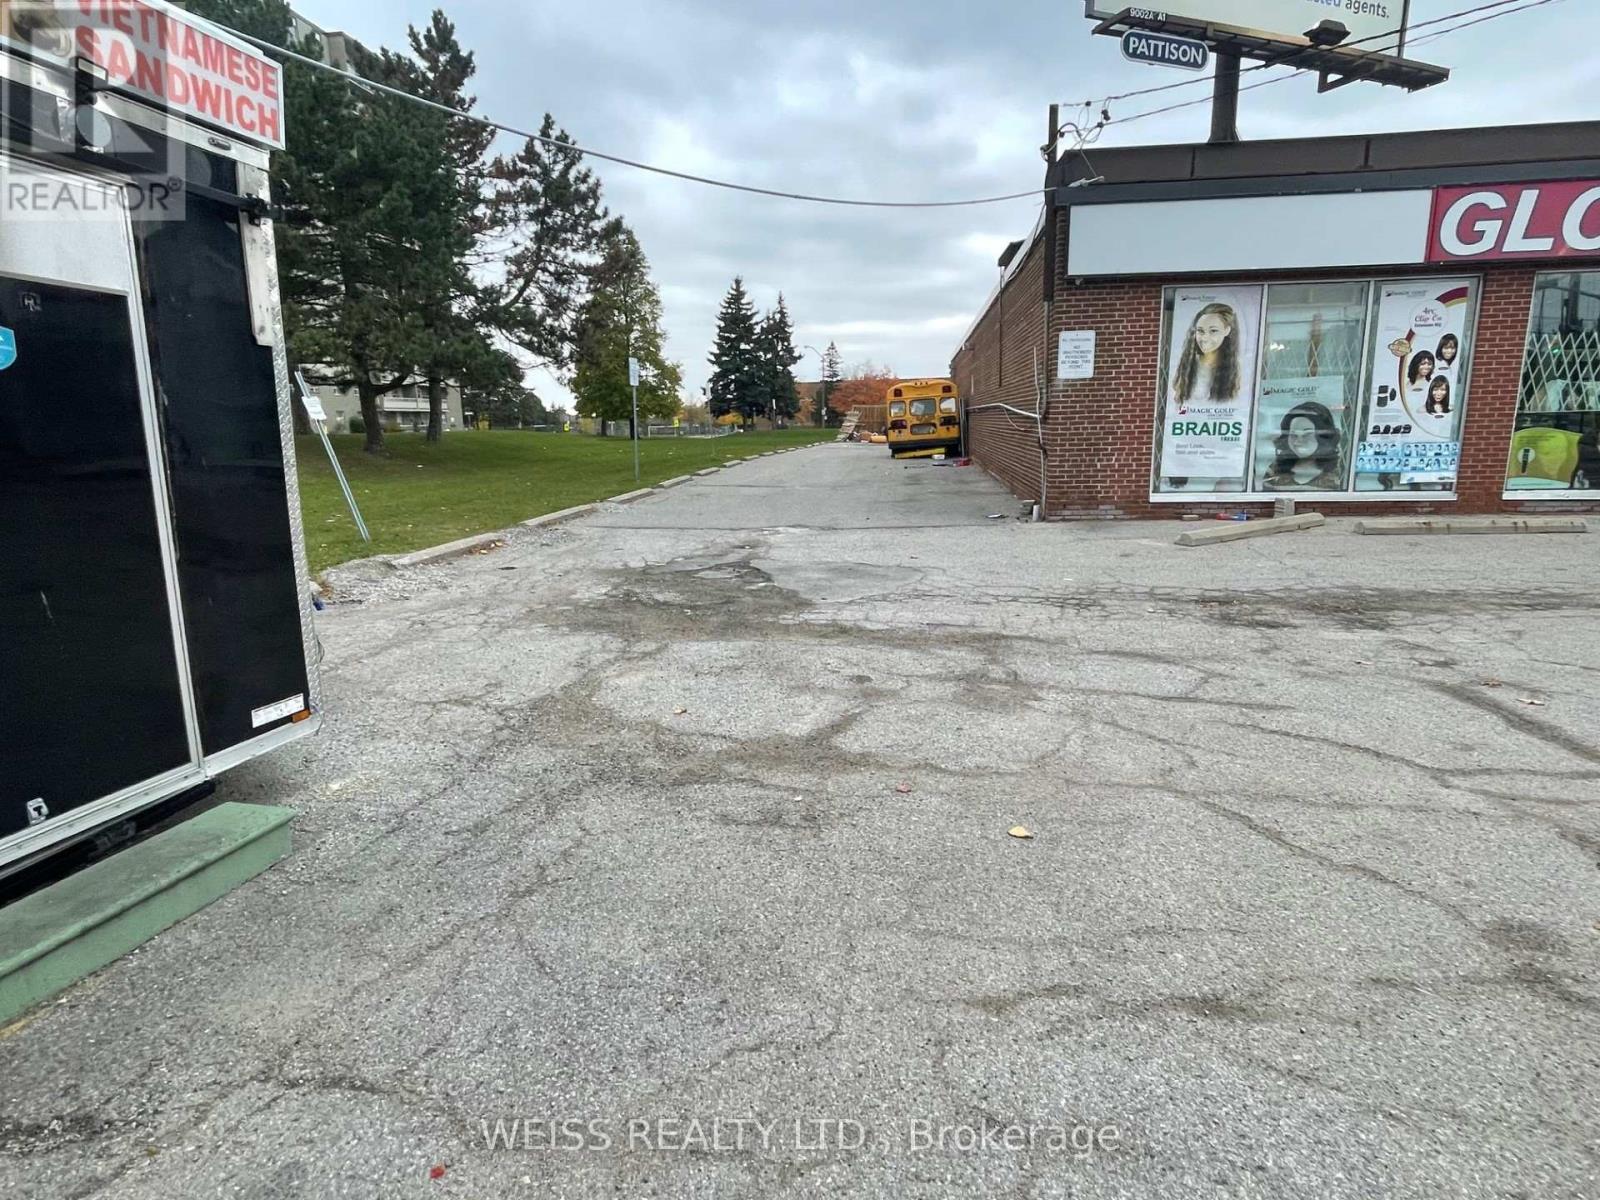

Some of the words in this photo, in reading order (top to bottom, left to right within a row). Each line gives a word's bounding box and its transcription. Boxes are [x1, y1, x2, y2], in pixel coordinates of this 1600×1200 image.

[1130, 8, 1154, 20] 9002A
[1345, 0, 1390, 19] agents.
[1128, 36, 1203, 65] PATTISON
[75, 25, 279, 142] SANDWICH
[1172, 421, 1242, 436] BRAIDS
